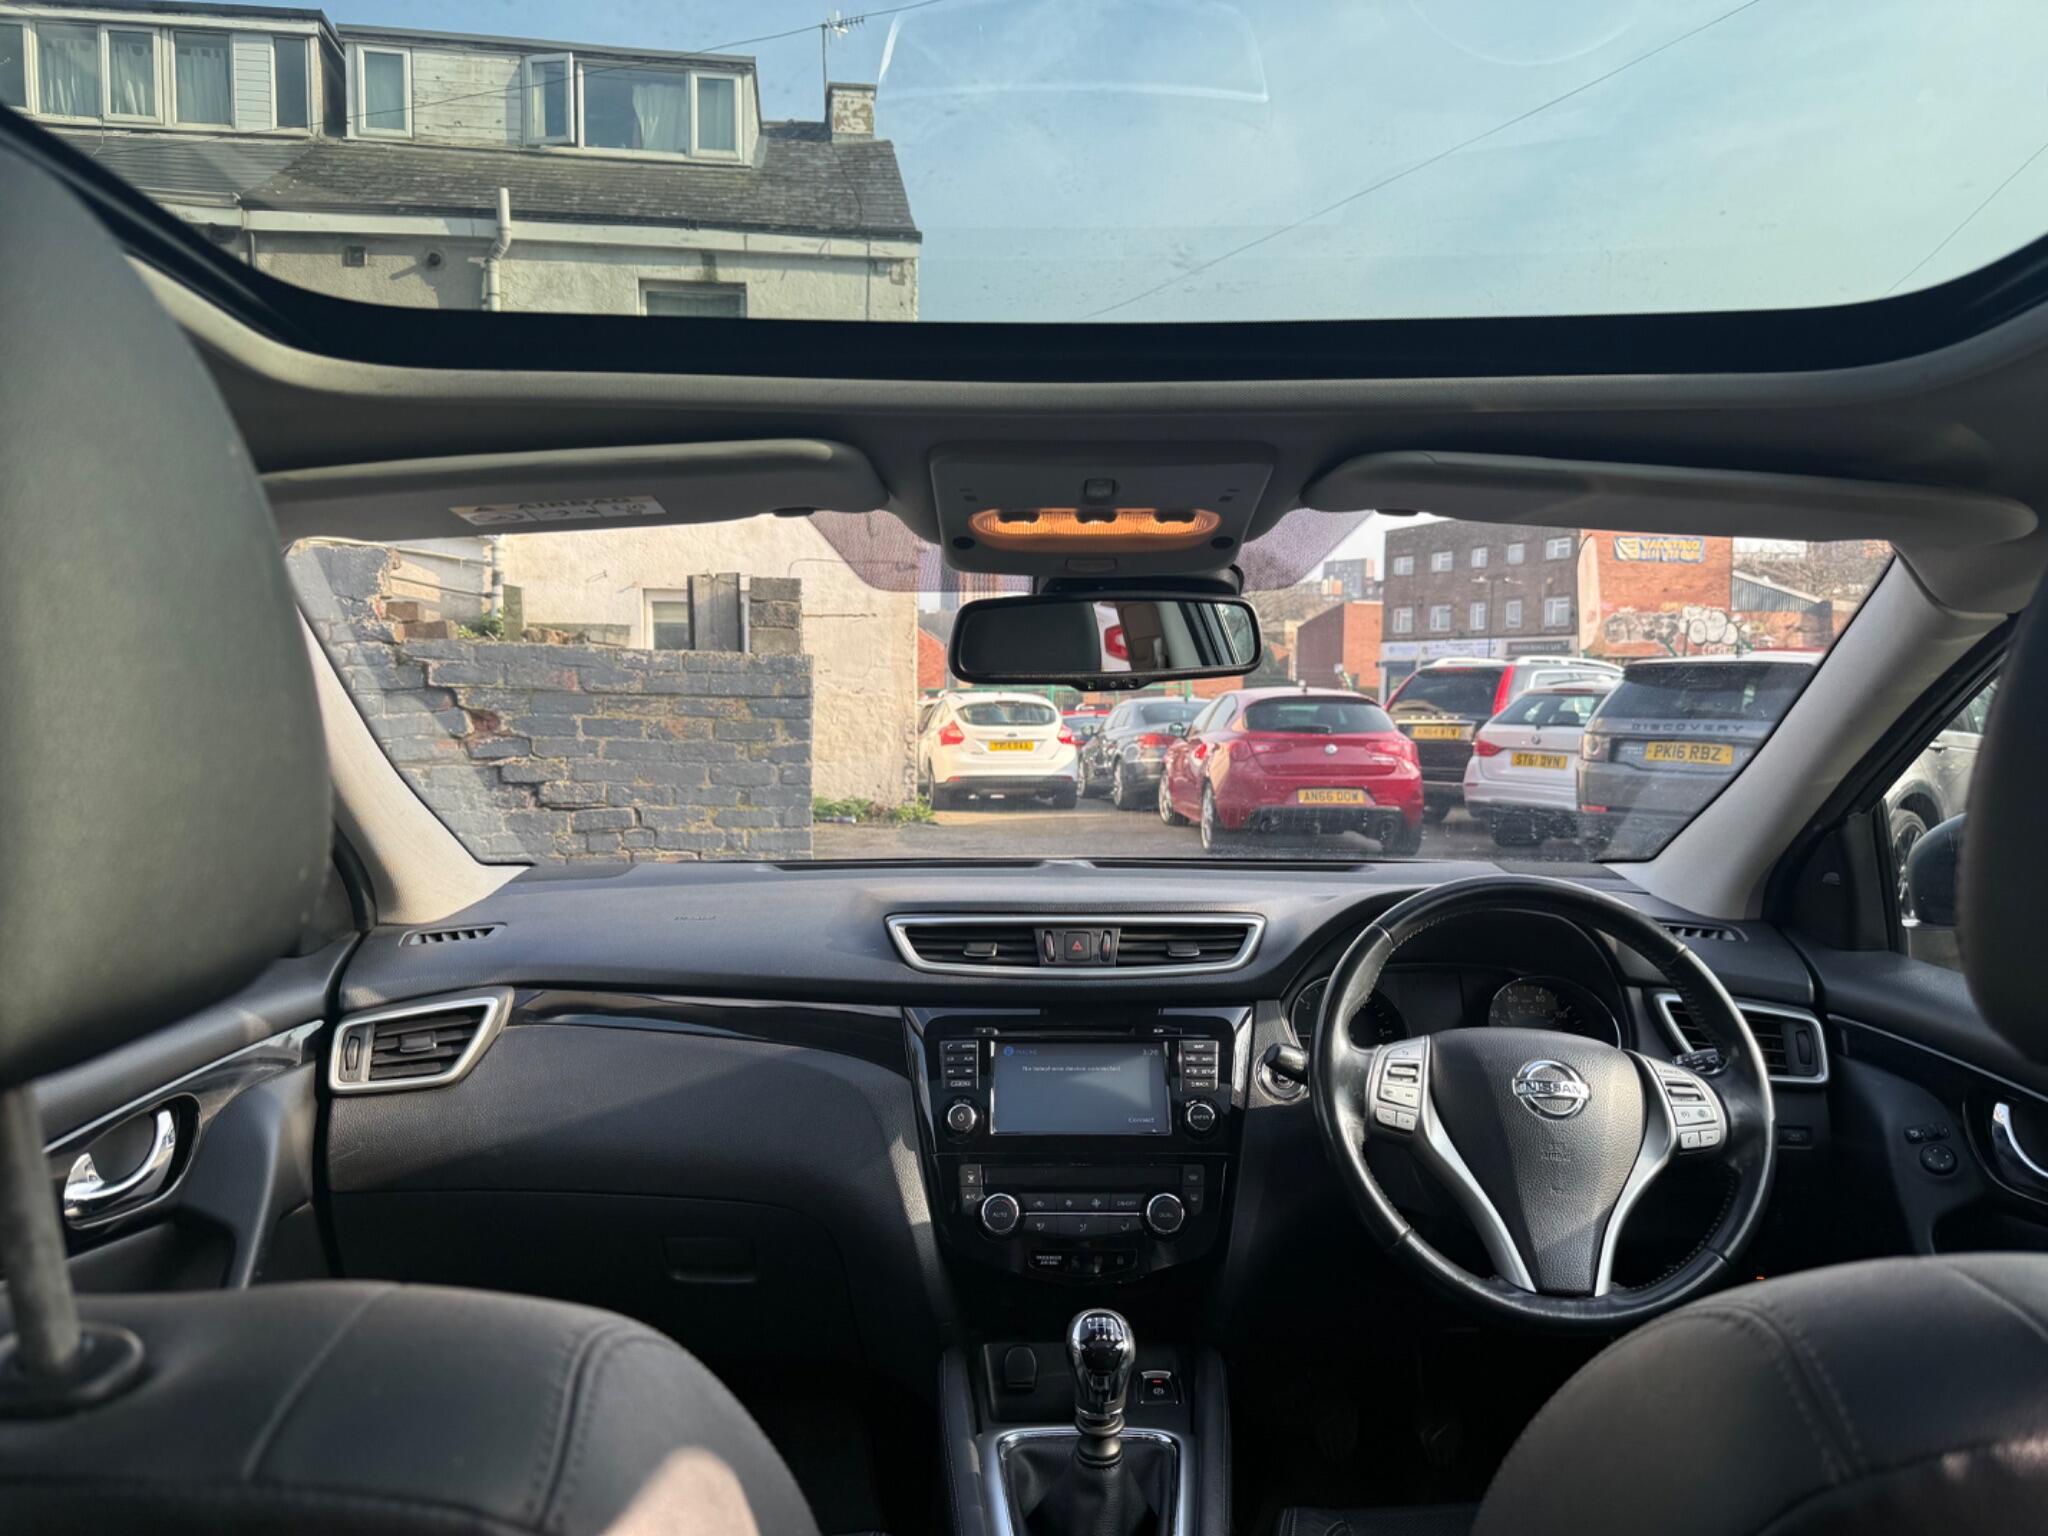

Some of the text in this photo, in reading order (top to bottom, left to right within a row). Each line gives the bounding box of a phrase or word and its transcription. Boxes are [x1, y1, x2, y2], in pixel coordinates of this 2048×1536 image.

[1631, 722, 1744, 732] DISCOVERY
[1654, 744, 1686, 759] PK16
[1689, 745, 1723, 761] RBZ
[1524, 1081, 1581, 1095] NISSAN
